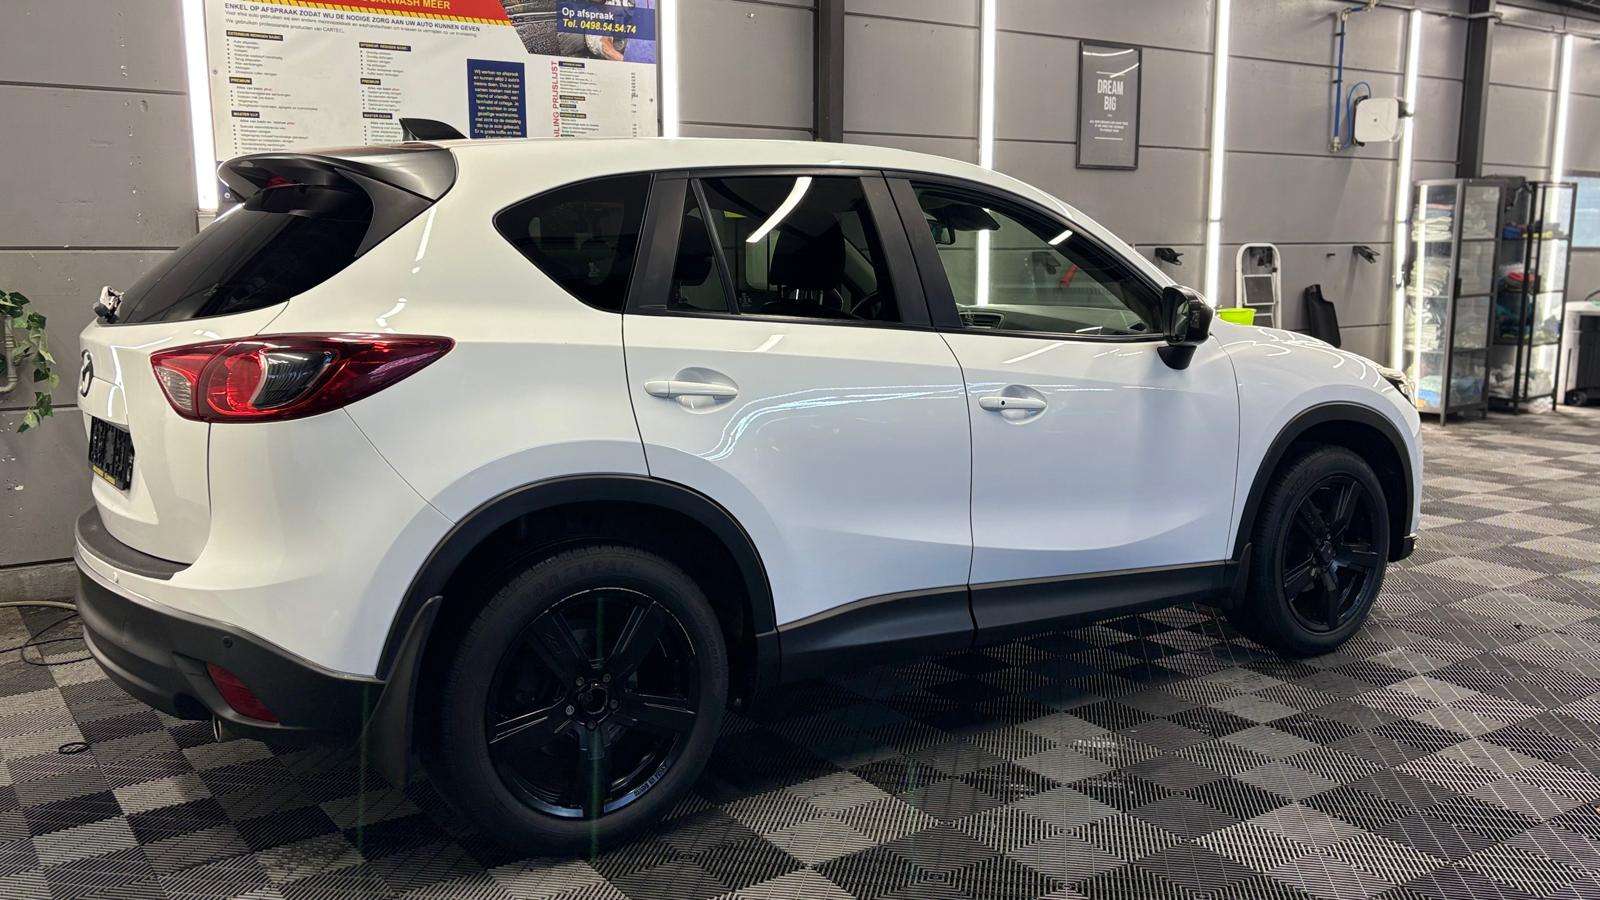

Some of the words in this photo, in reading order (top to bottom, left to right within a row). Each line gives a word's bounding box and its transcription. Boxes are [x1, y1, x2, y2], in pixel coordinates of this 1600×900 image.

[423, 0, 451, 9] MEER
[225, 3, 248, 11] ENKEL
[261, 6, 298, 15] AFSPRAAK
[346, 14, 371, 22] NODIGE
[434, 22, 460, 30] KUNNEN
[562, 7, 575, 16] Op
[577, 9, 614, 20] afspraak
[563, 18, 578, 28] Tel.
[580, 20, 637, 33] 0498.54.54.74
[551, 61, 559, 109] PRIJSLIJST
[1097, 79, 1124, 95] DREAM
[1104, 96, 1117, 111] BIG
